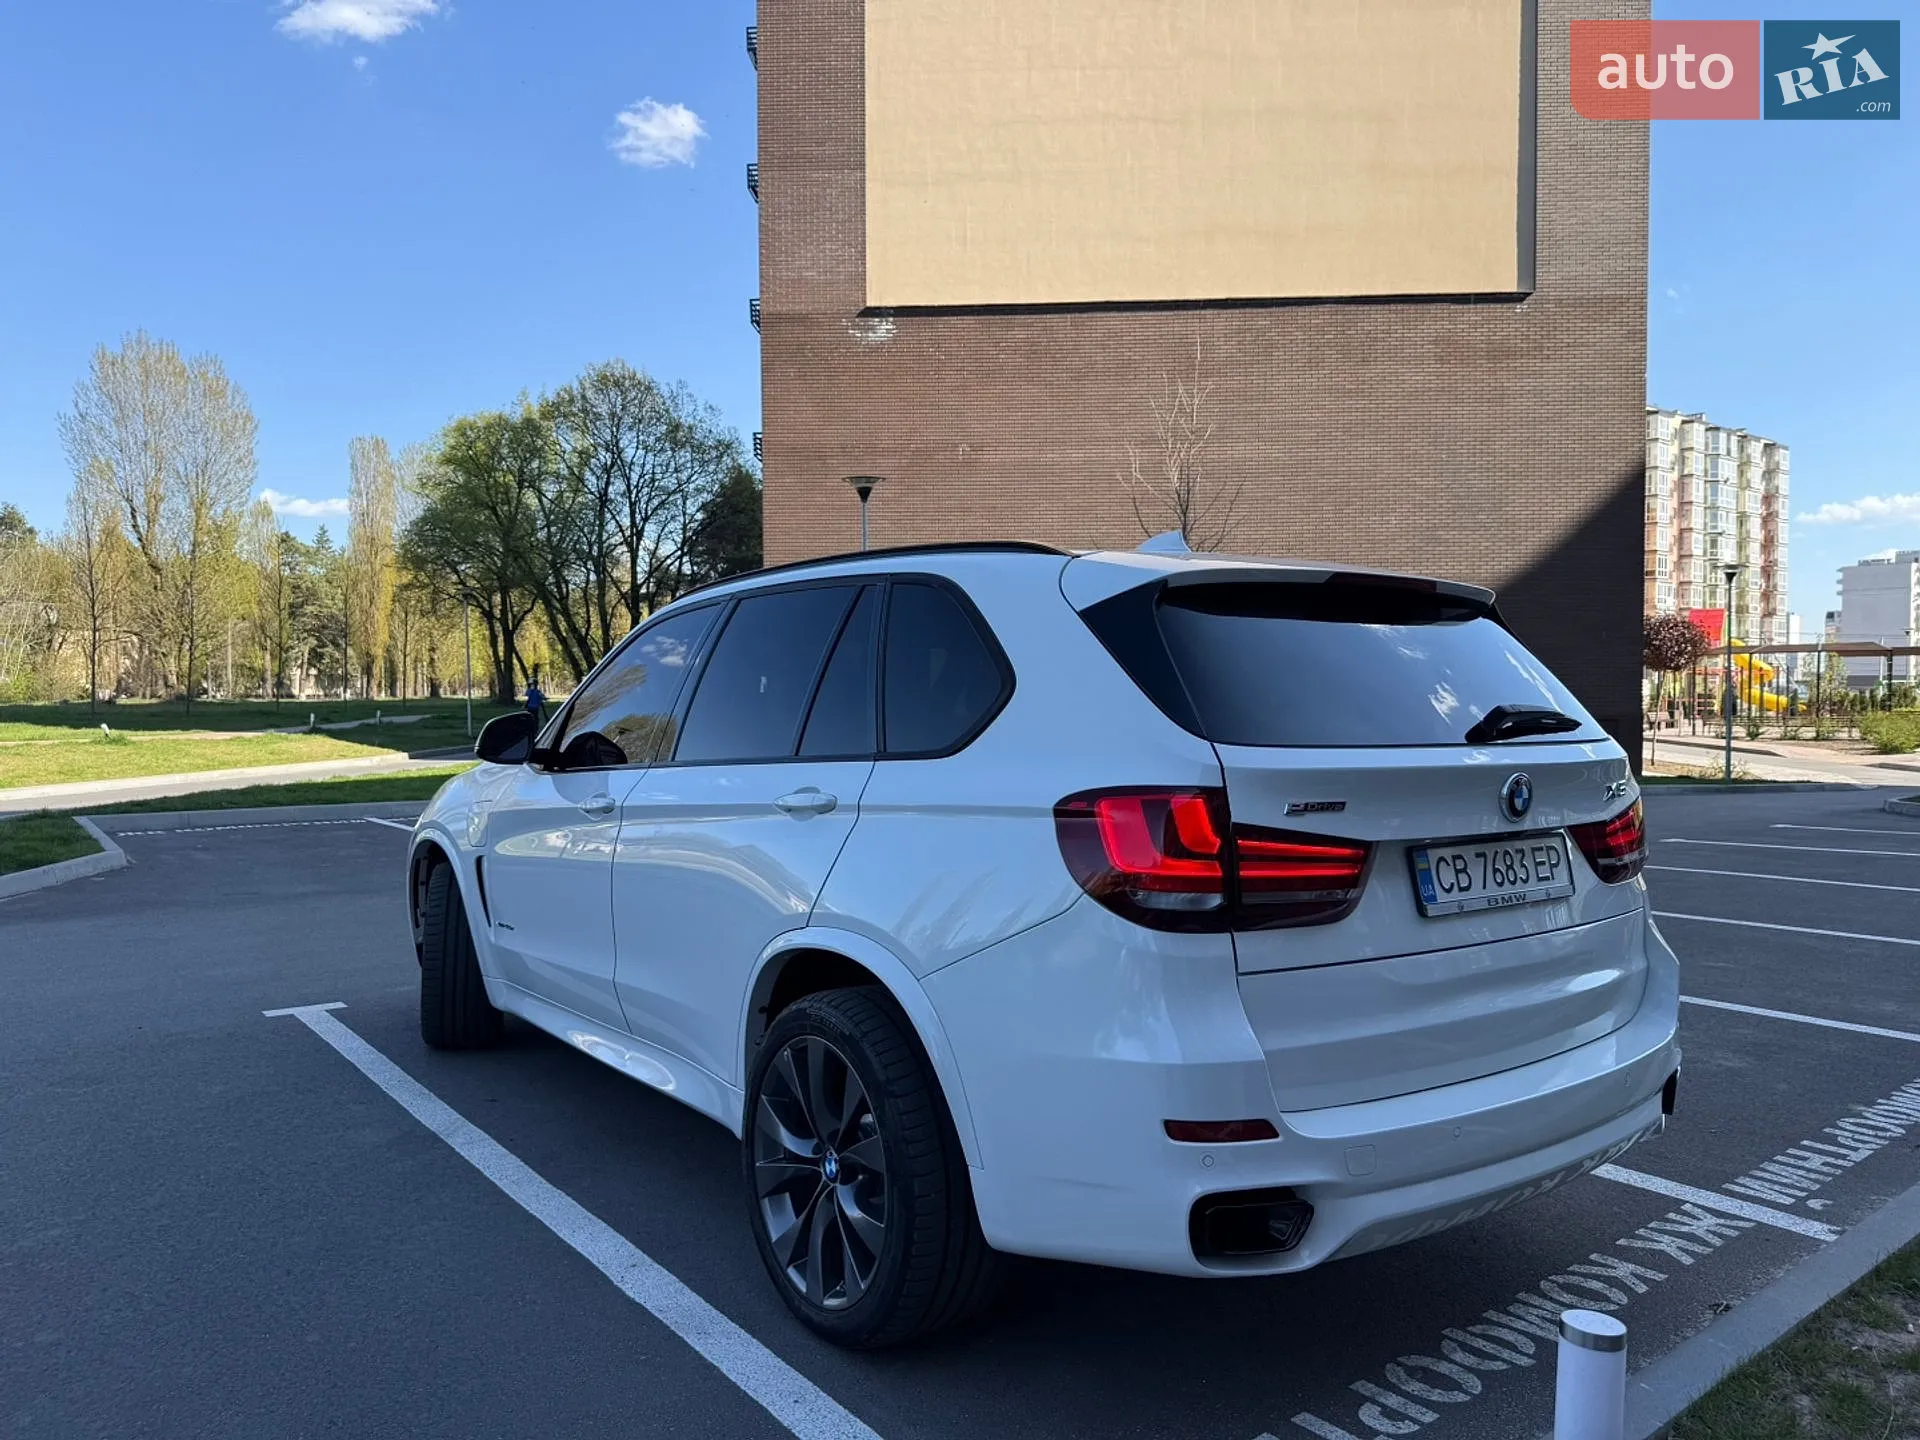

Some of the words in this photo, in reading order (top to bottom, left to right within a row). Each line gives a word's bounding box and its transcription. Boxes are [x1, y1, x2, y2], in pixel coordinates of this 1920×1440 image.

[1436, 854, 1472, 894] CB
[1475, 848, 1529, 890] 7683
[1531, 844, 1561, 882] EP
[1421, 885, 1435, 896] UA
[1487, 893, 1527, 906] BMW
[1615, 1202, 1757, 1265] ЖК
